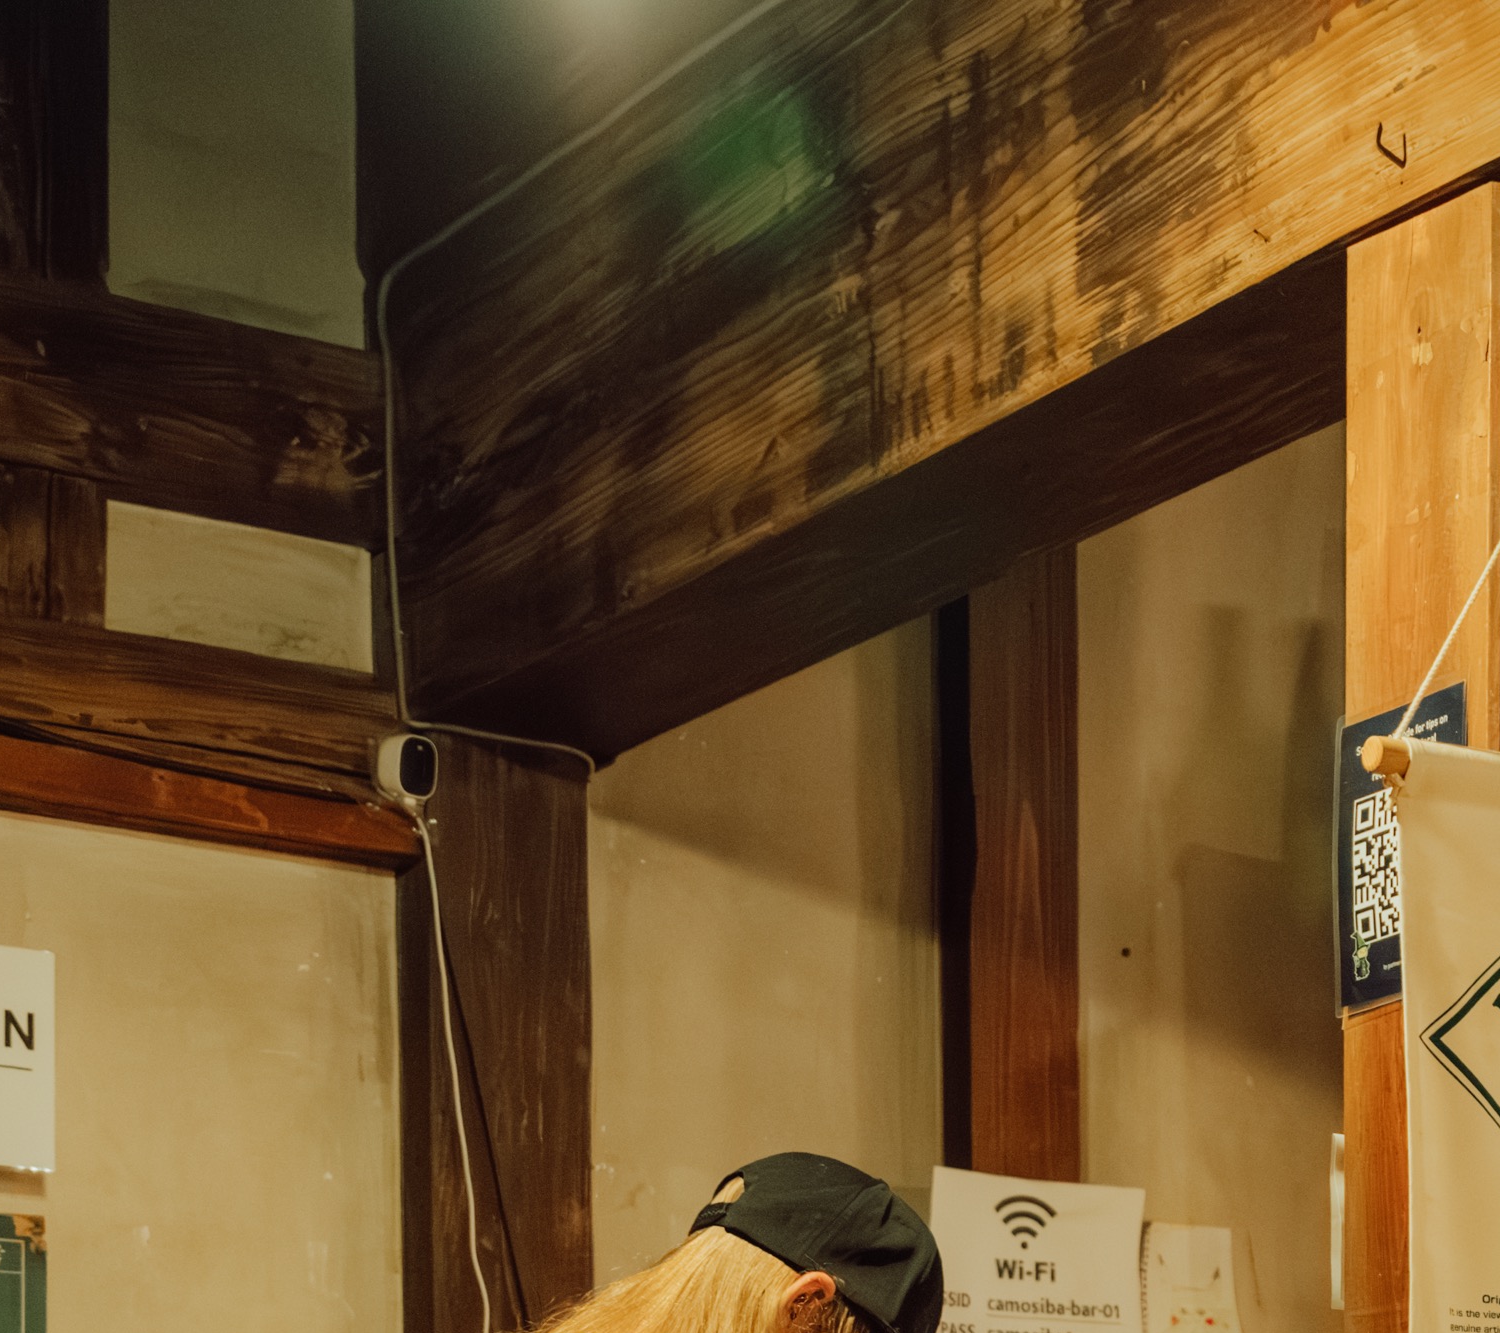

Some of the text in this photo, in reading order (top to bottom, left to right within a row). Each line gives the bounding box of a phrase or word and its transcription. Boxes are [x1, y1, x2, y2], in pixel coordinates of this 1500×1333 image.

[995, 1258, 1056, 1283] Wi-Fi
[987, 1298, 1120, 1319] camosiba-bar-01
[1466, 1310, 1480, 1318] the
